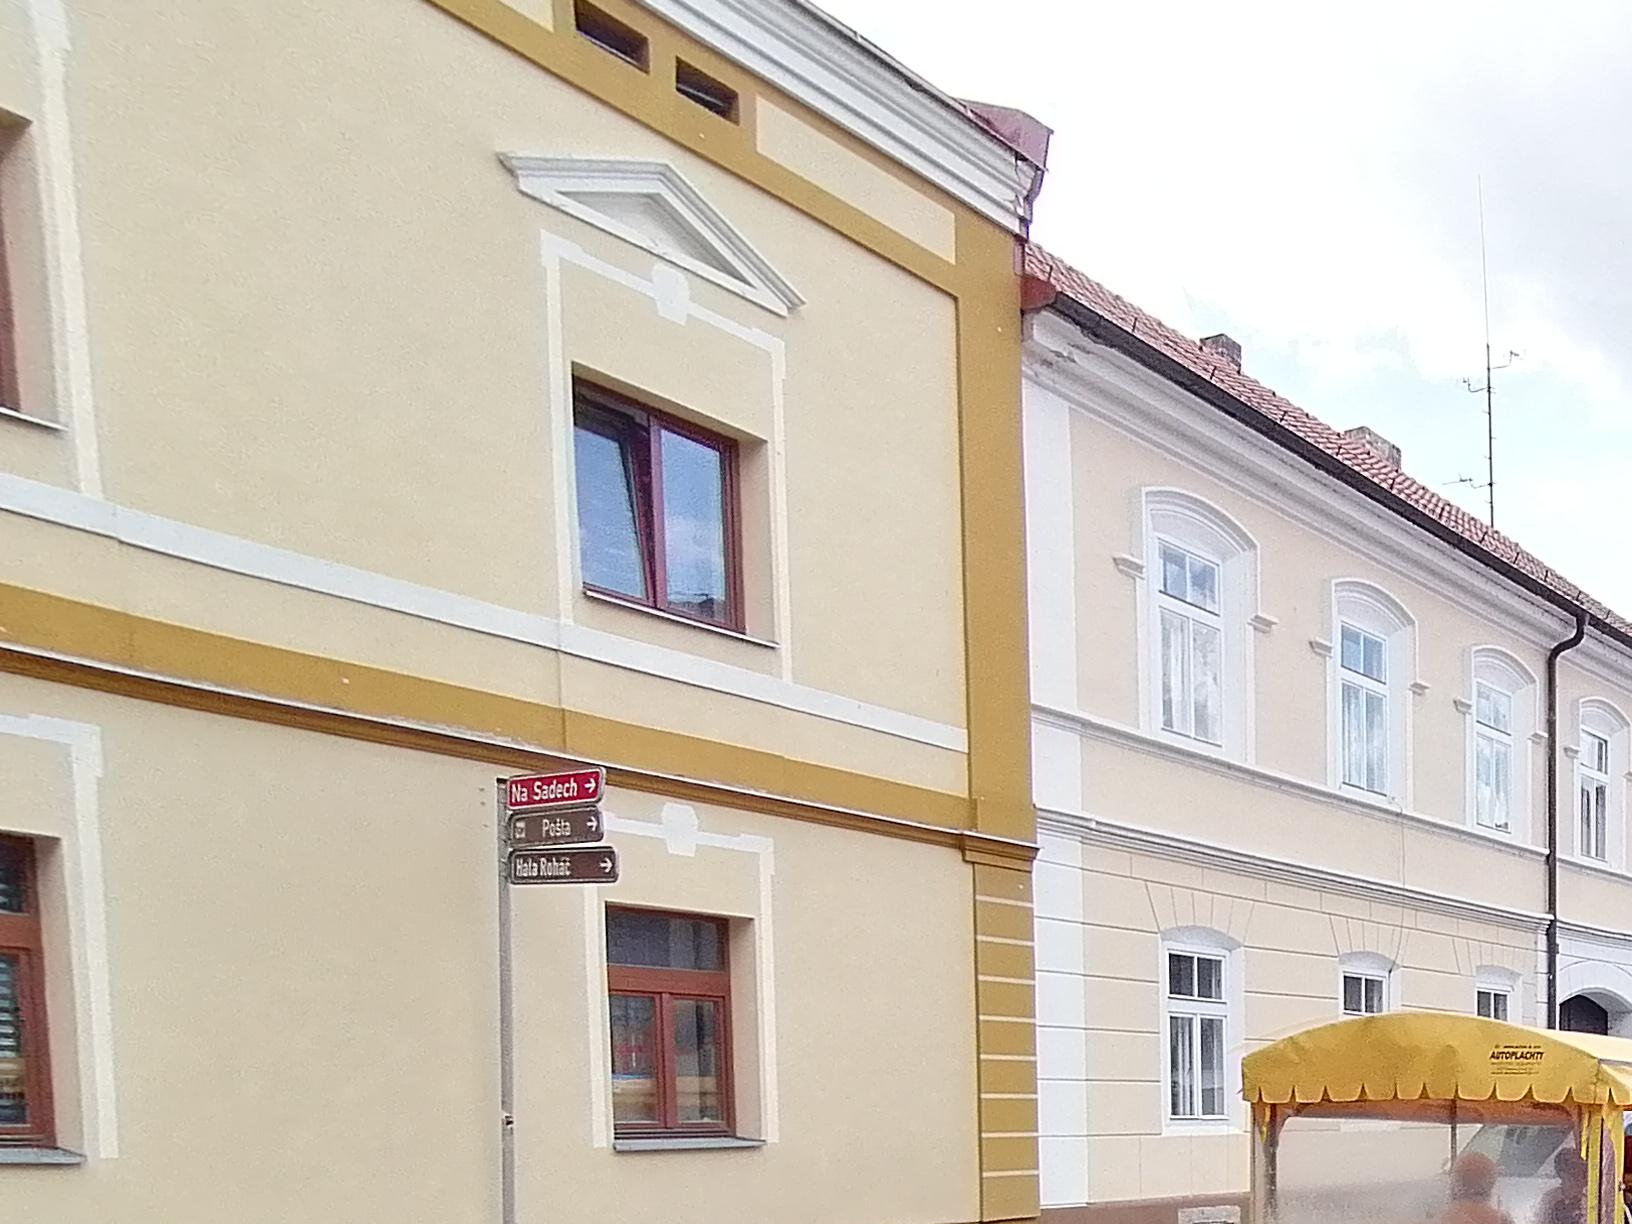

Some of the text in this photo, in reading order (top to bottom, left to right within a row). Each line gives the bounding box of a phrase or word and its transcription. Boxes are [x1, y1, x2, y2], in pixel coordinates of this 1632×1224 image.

[511, 777, 578, 803] Na Sadech
[542, 818, 571, 837] Pošta
[516, 857, 538, 877] Hala
